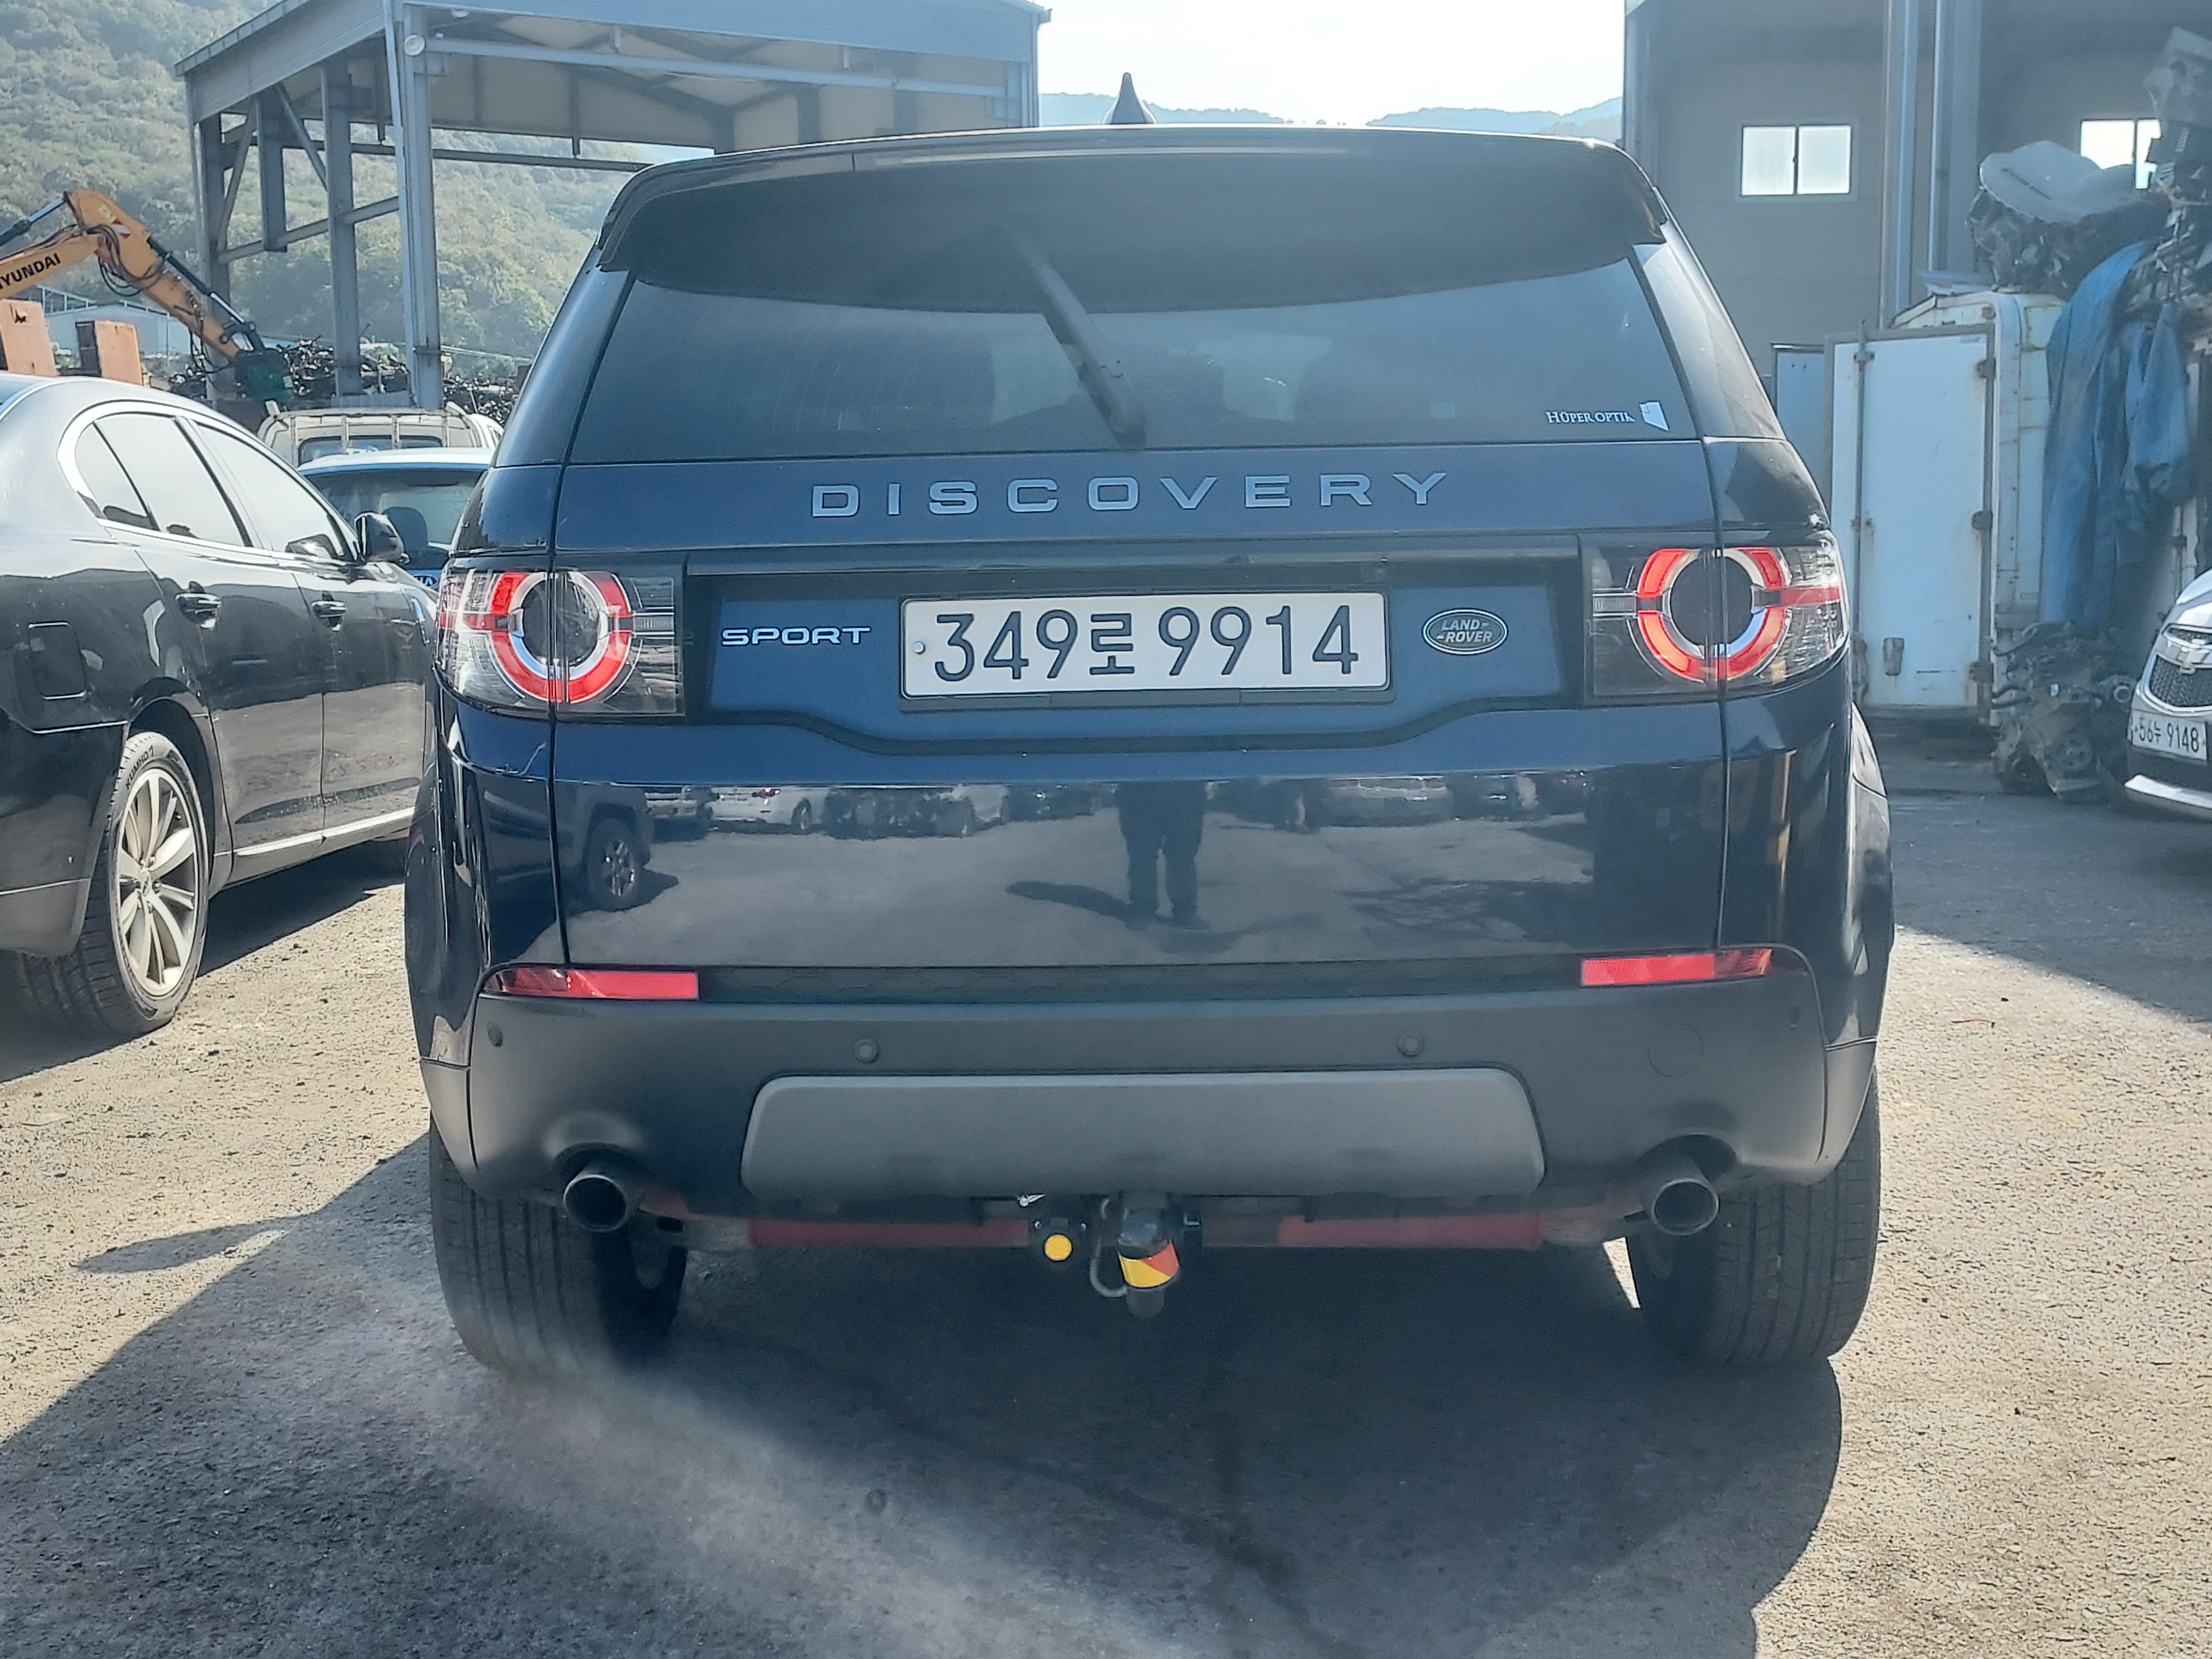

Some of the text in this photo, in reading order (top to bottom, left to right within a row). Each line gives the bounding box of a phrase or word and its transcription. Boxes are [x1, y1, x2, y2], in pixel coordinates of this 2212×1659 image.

[812, 473, 1447, 517] DISCOVERY
[1442, 619, 1481, 631] LAND
[722, 627, 871, 645] SPORT
[1445, 631, 1493, 643] ROVER
